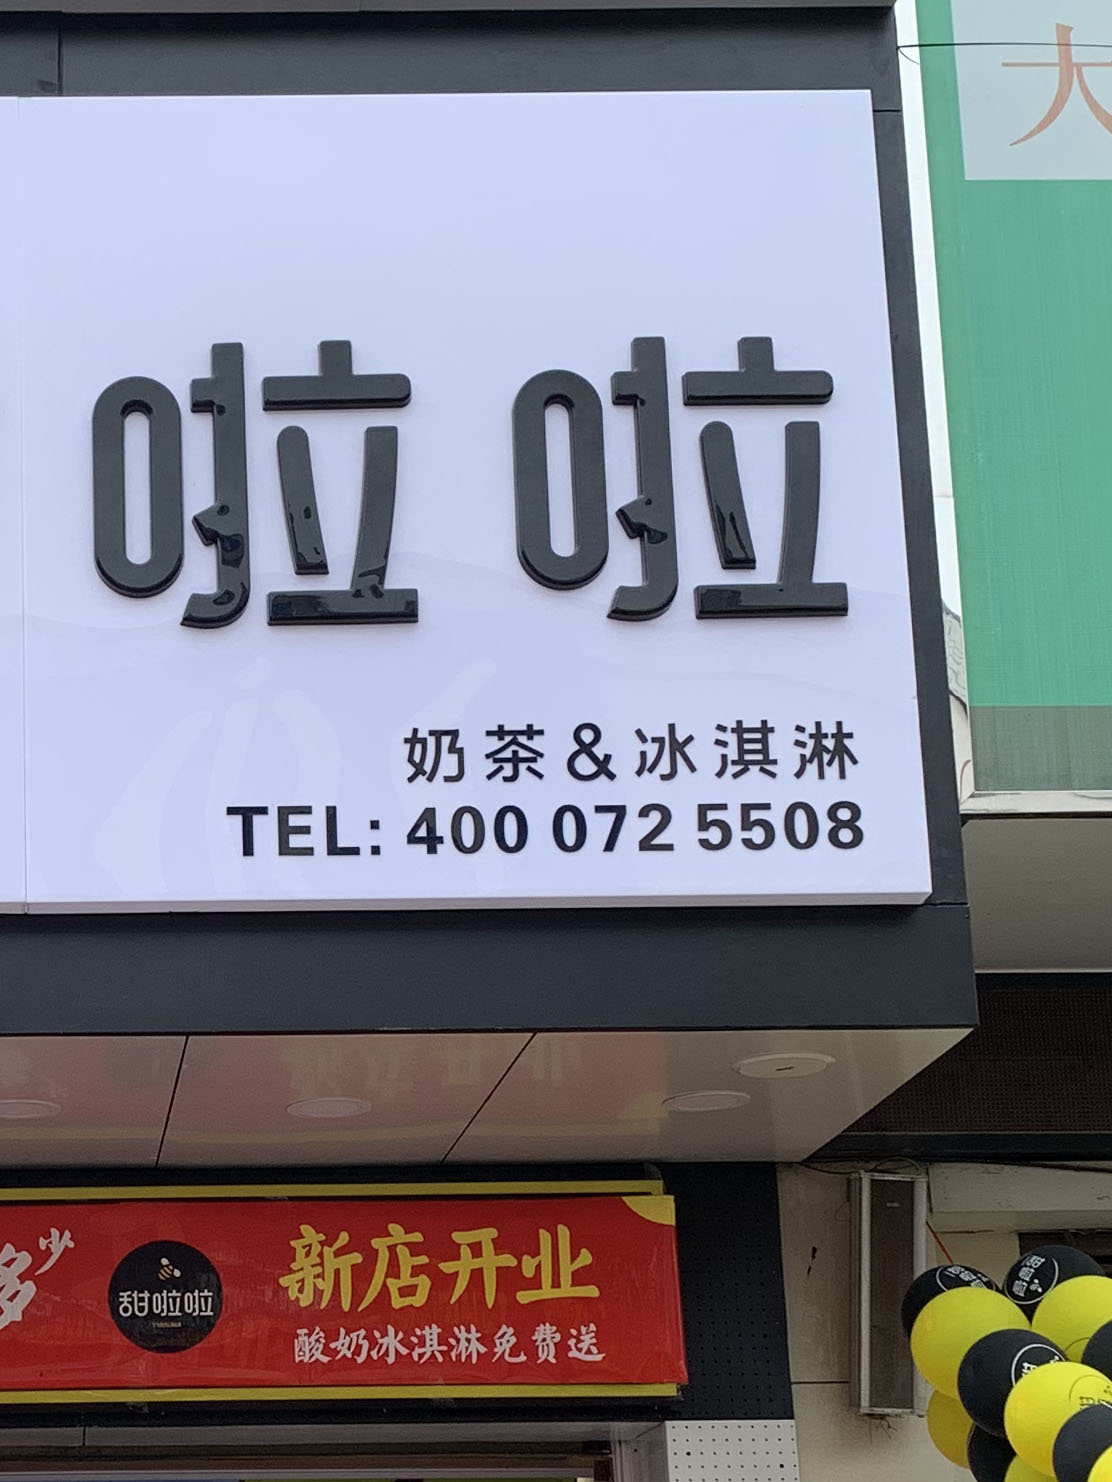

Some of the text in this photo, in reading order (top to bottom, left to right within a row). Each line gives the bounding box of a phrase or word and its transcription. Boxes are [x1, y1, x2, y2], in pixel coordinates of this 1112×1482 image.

[404, 720, 860, 784] 奶茶&冰淇淋
[227, 801, 865, 857] TEL: 400 072 5508
[278, 1222, 602, 1312] 新店开业
[118, 1287, 214, 1319] 甜啦啦
[293, 1321, 606, 1366] 酸奶冰淇淋免费送
